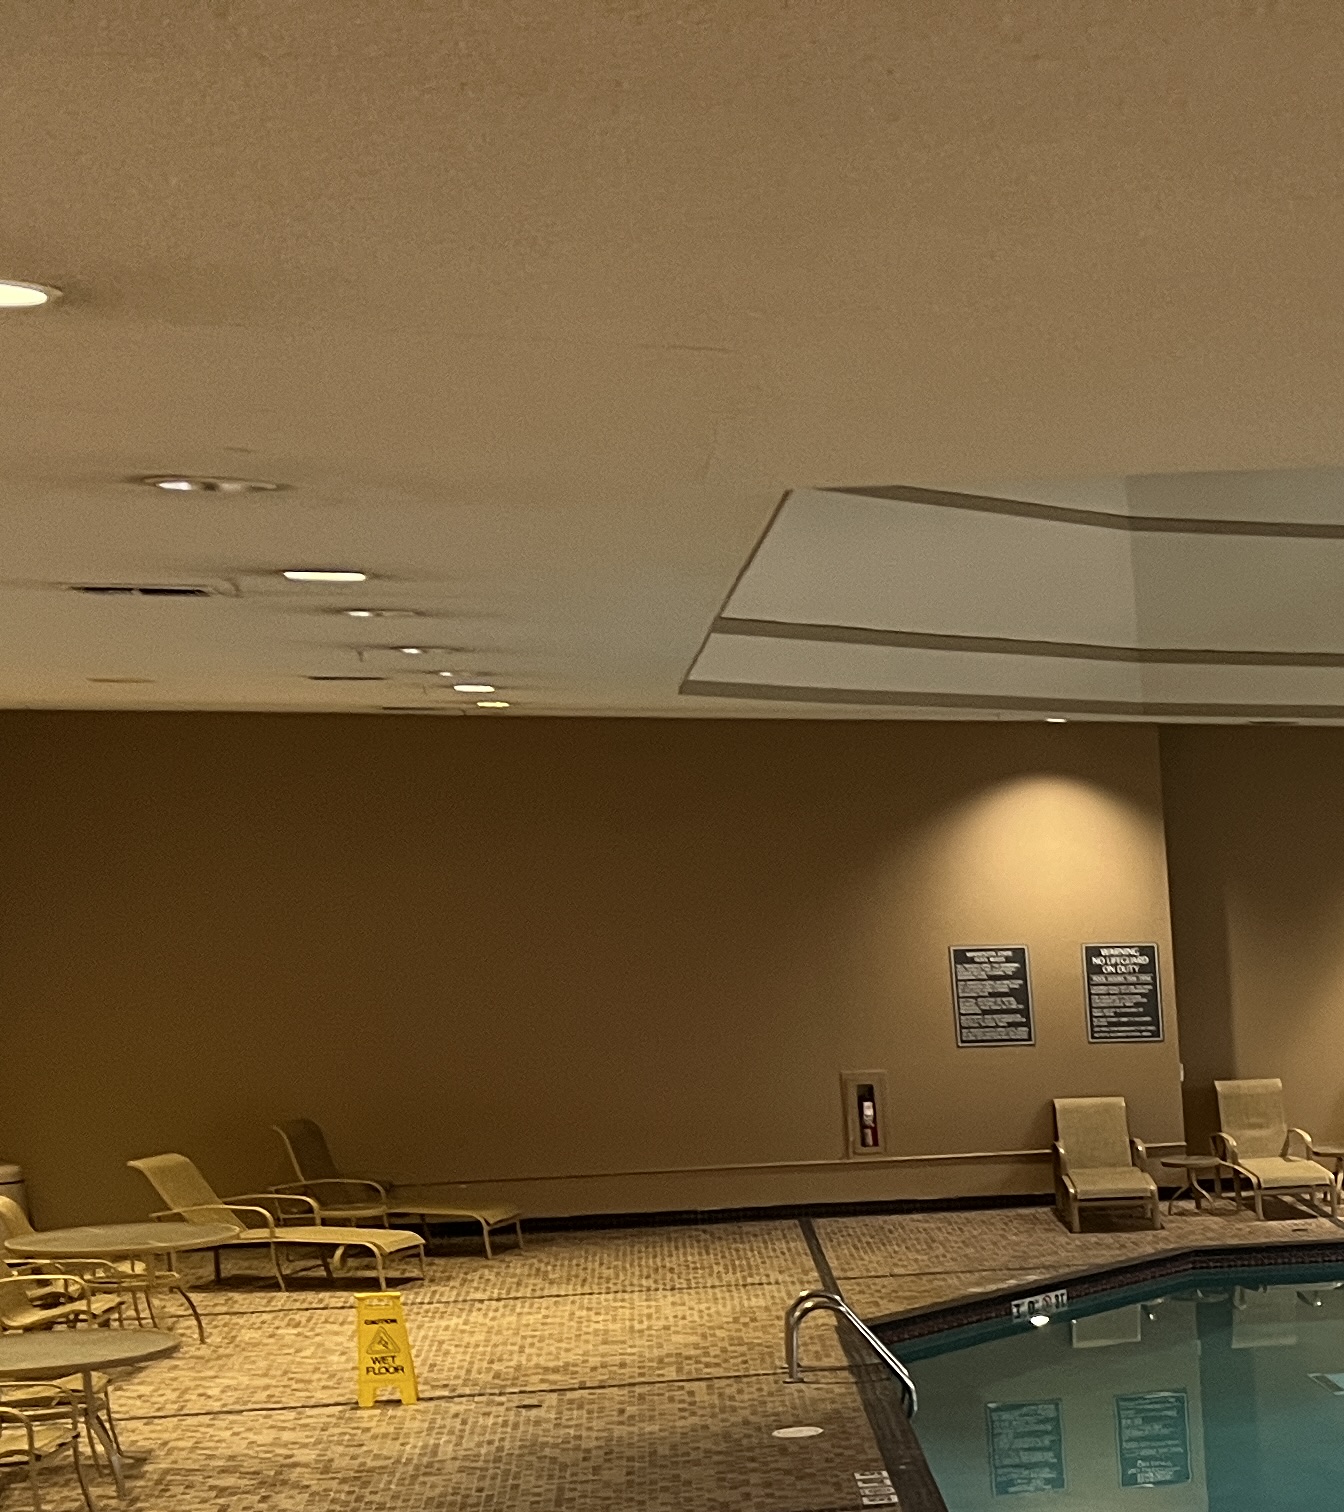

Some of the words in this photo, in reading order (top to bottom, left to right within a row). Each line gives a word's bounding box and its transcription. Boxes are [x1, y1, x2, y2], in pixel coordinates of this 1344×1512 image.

[1091, 955, 1106, 965] NO
[1106, 955, 1150, 965] LIFEGUARD
[1102, 965, 1116, 974] ON
[1116, 965, 1141, 974] DUTY
[370, 1355, 397, 1365] WET
[366, 1365, 405, 1376] FLOOR
